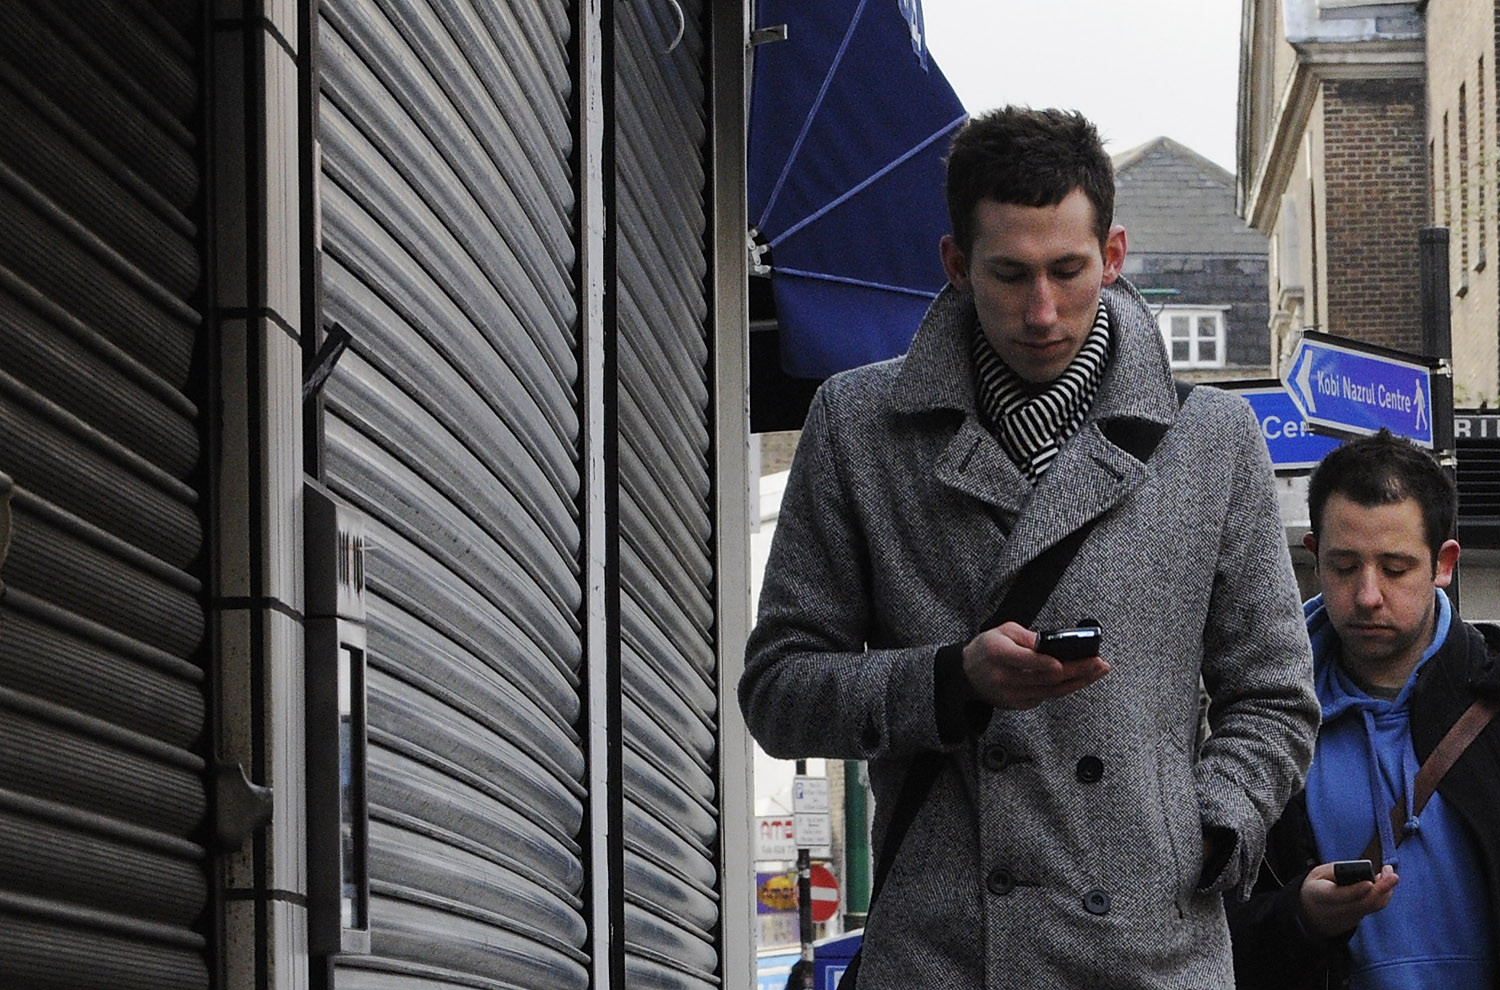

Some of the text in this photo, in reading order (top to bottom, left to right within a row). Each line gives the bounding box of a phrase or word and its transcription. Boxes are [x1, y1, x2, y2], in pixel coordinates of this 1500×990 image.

[1317, 370, 1411, 413] Kobi Nazrul Centre
